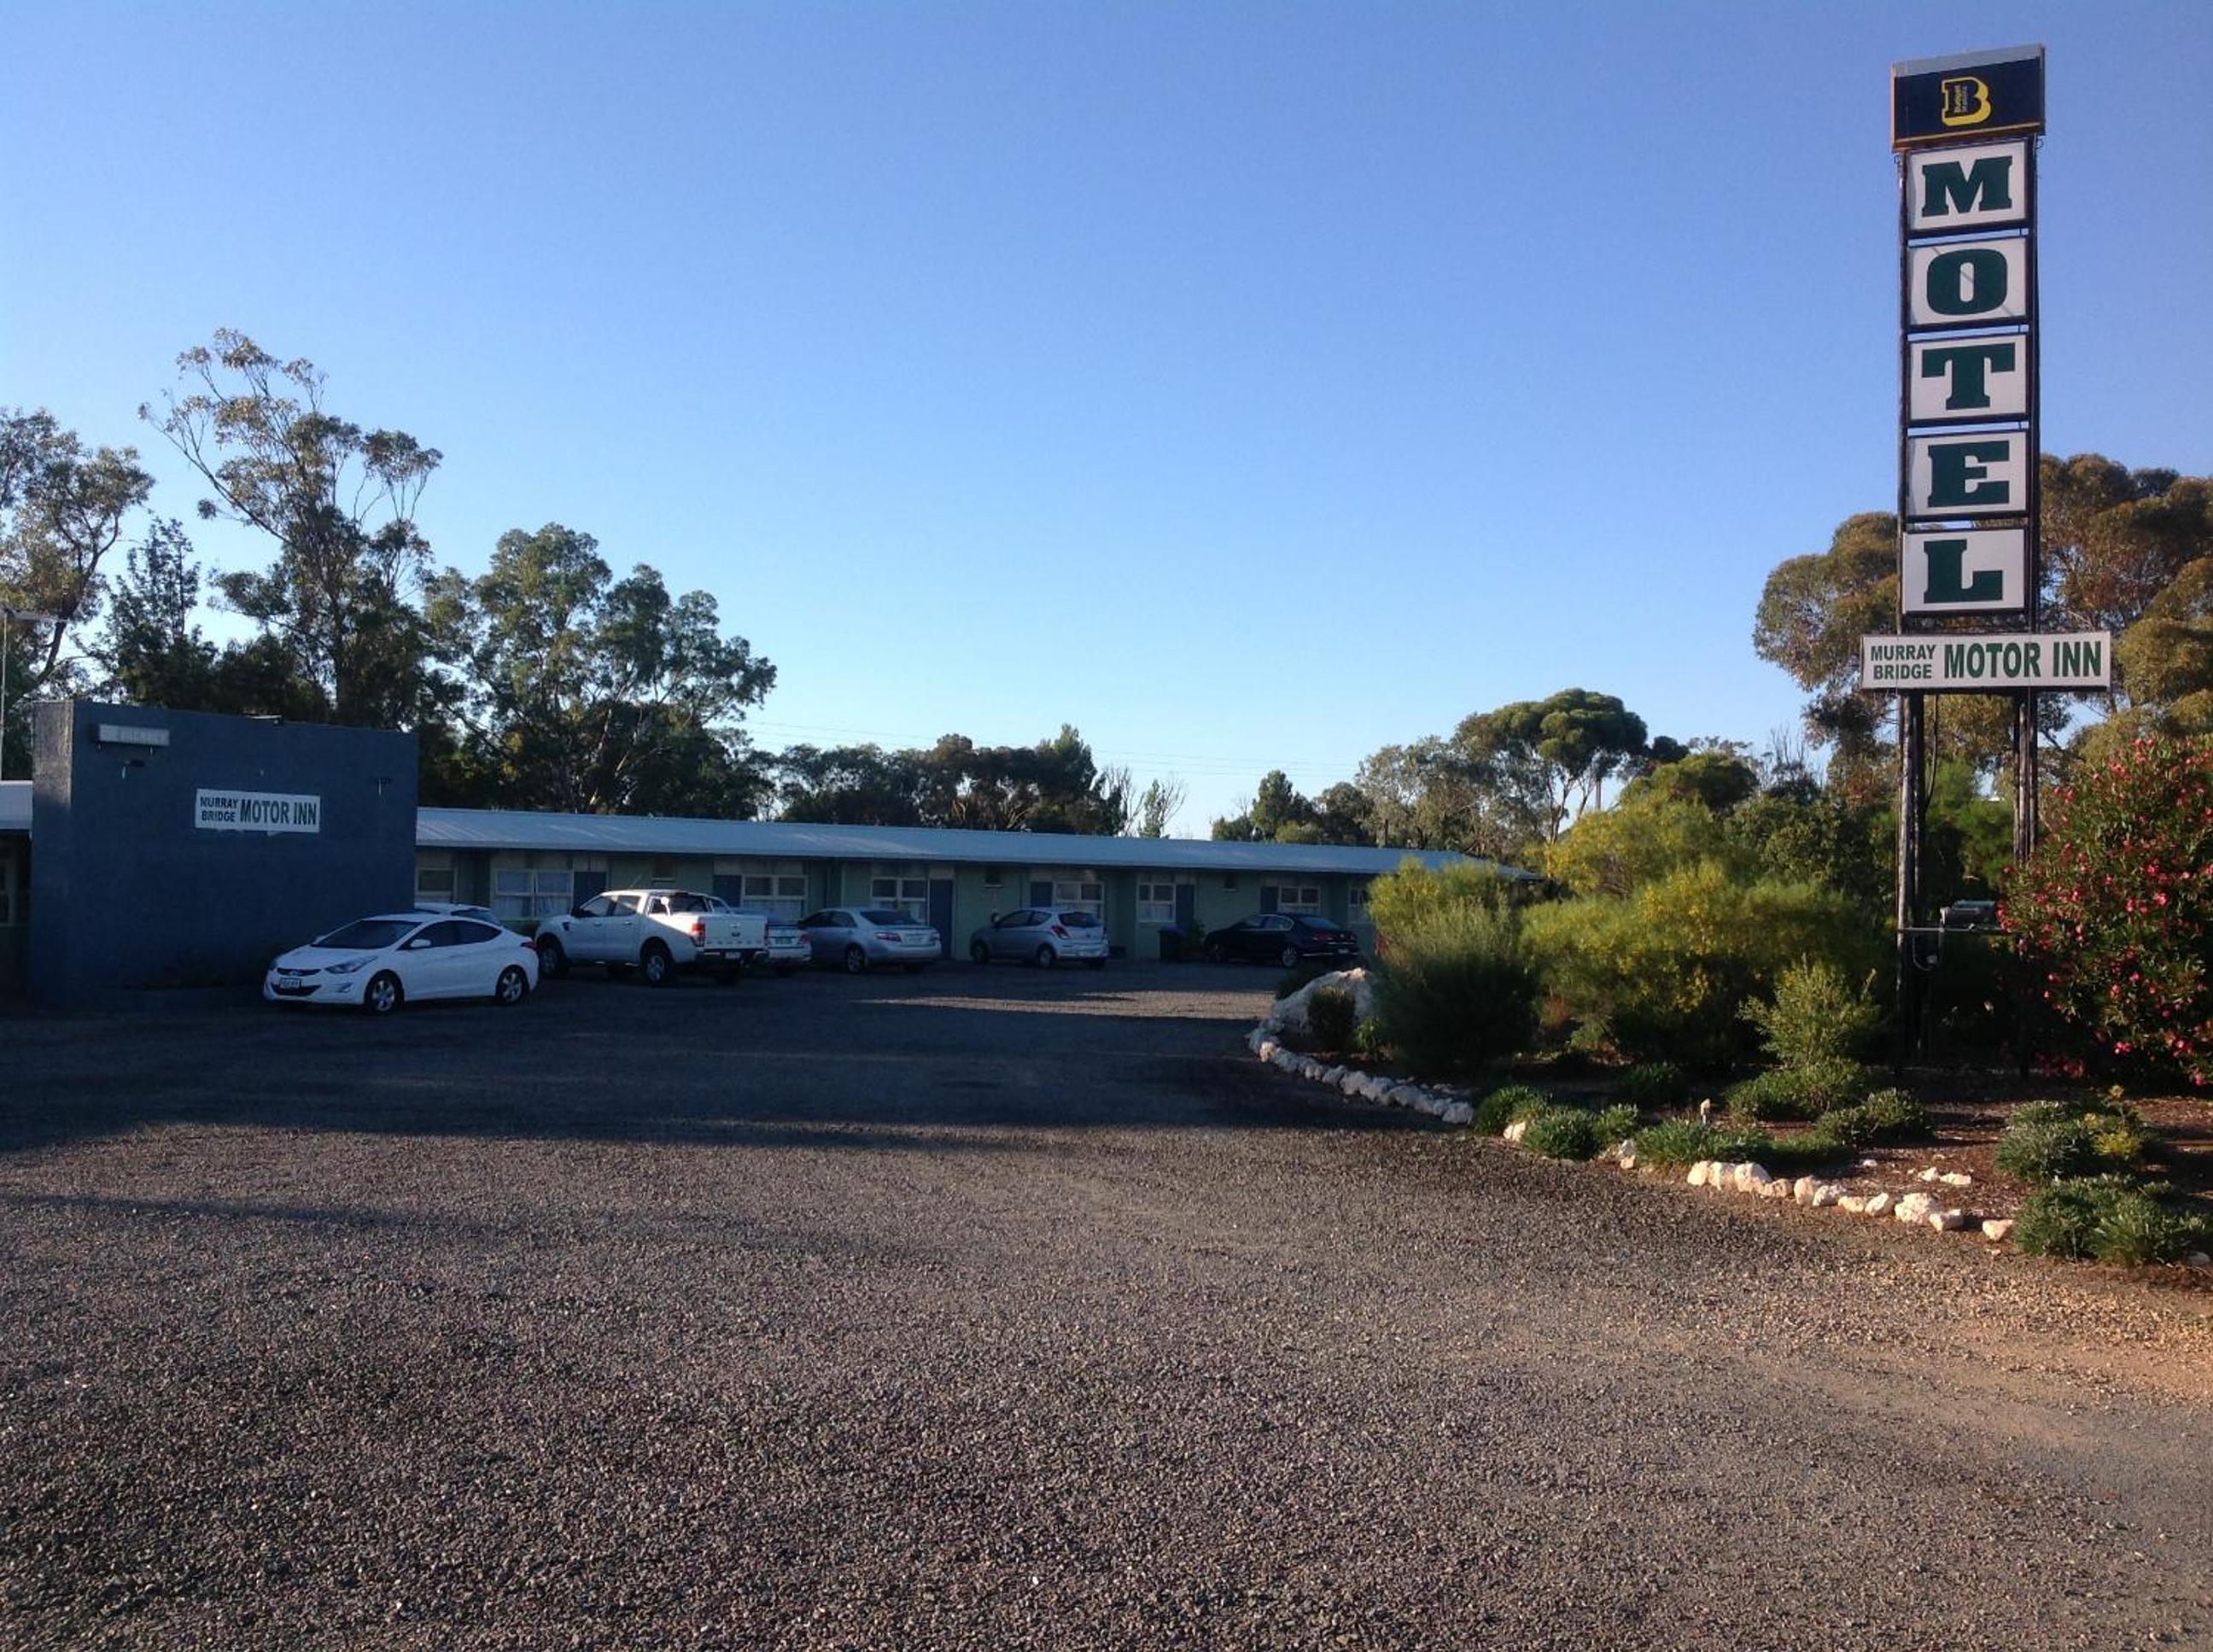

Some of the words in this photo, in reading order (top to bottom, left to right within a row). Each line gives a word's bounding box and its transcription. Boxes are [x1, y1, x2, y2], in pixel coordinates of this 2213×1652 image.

[1921, 155, 2016, 604] MOTEL
[1871, 645, 1936, 662] MURRAY
[1944, 642, 2041, 679] MOTOR
[2052, 641, 2102, 678] INN
[1873, 664, 1932, 680] BRIDGE
[200, 797, 239, 808] MURRAY
[201, 810, 236, 822] BRIDGE
[240, 799, 289, 824] MOTOR
[293, 802, 317, 826] INN
